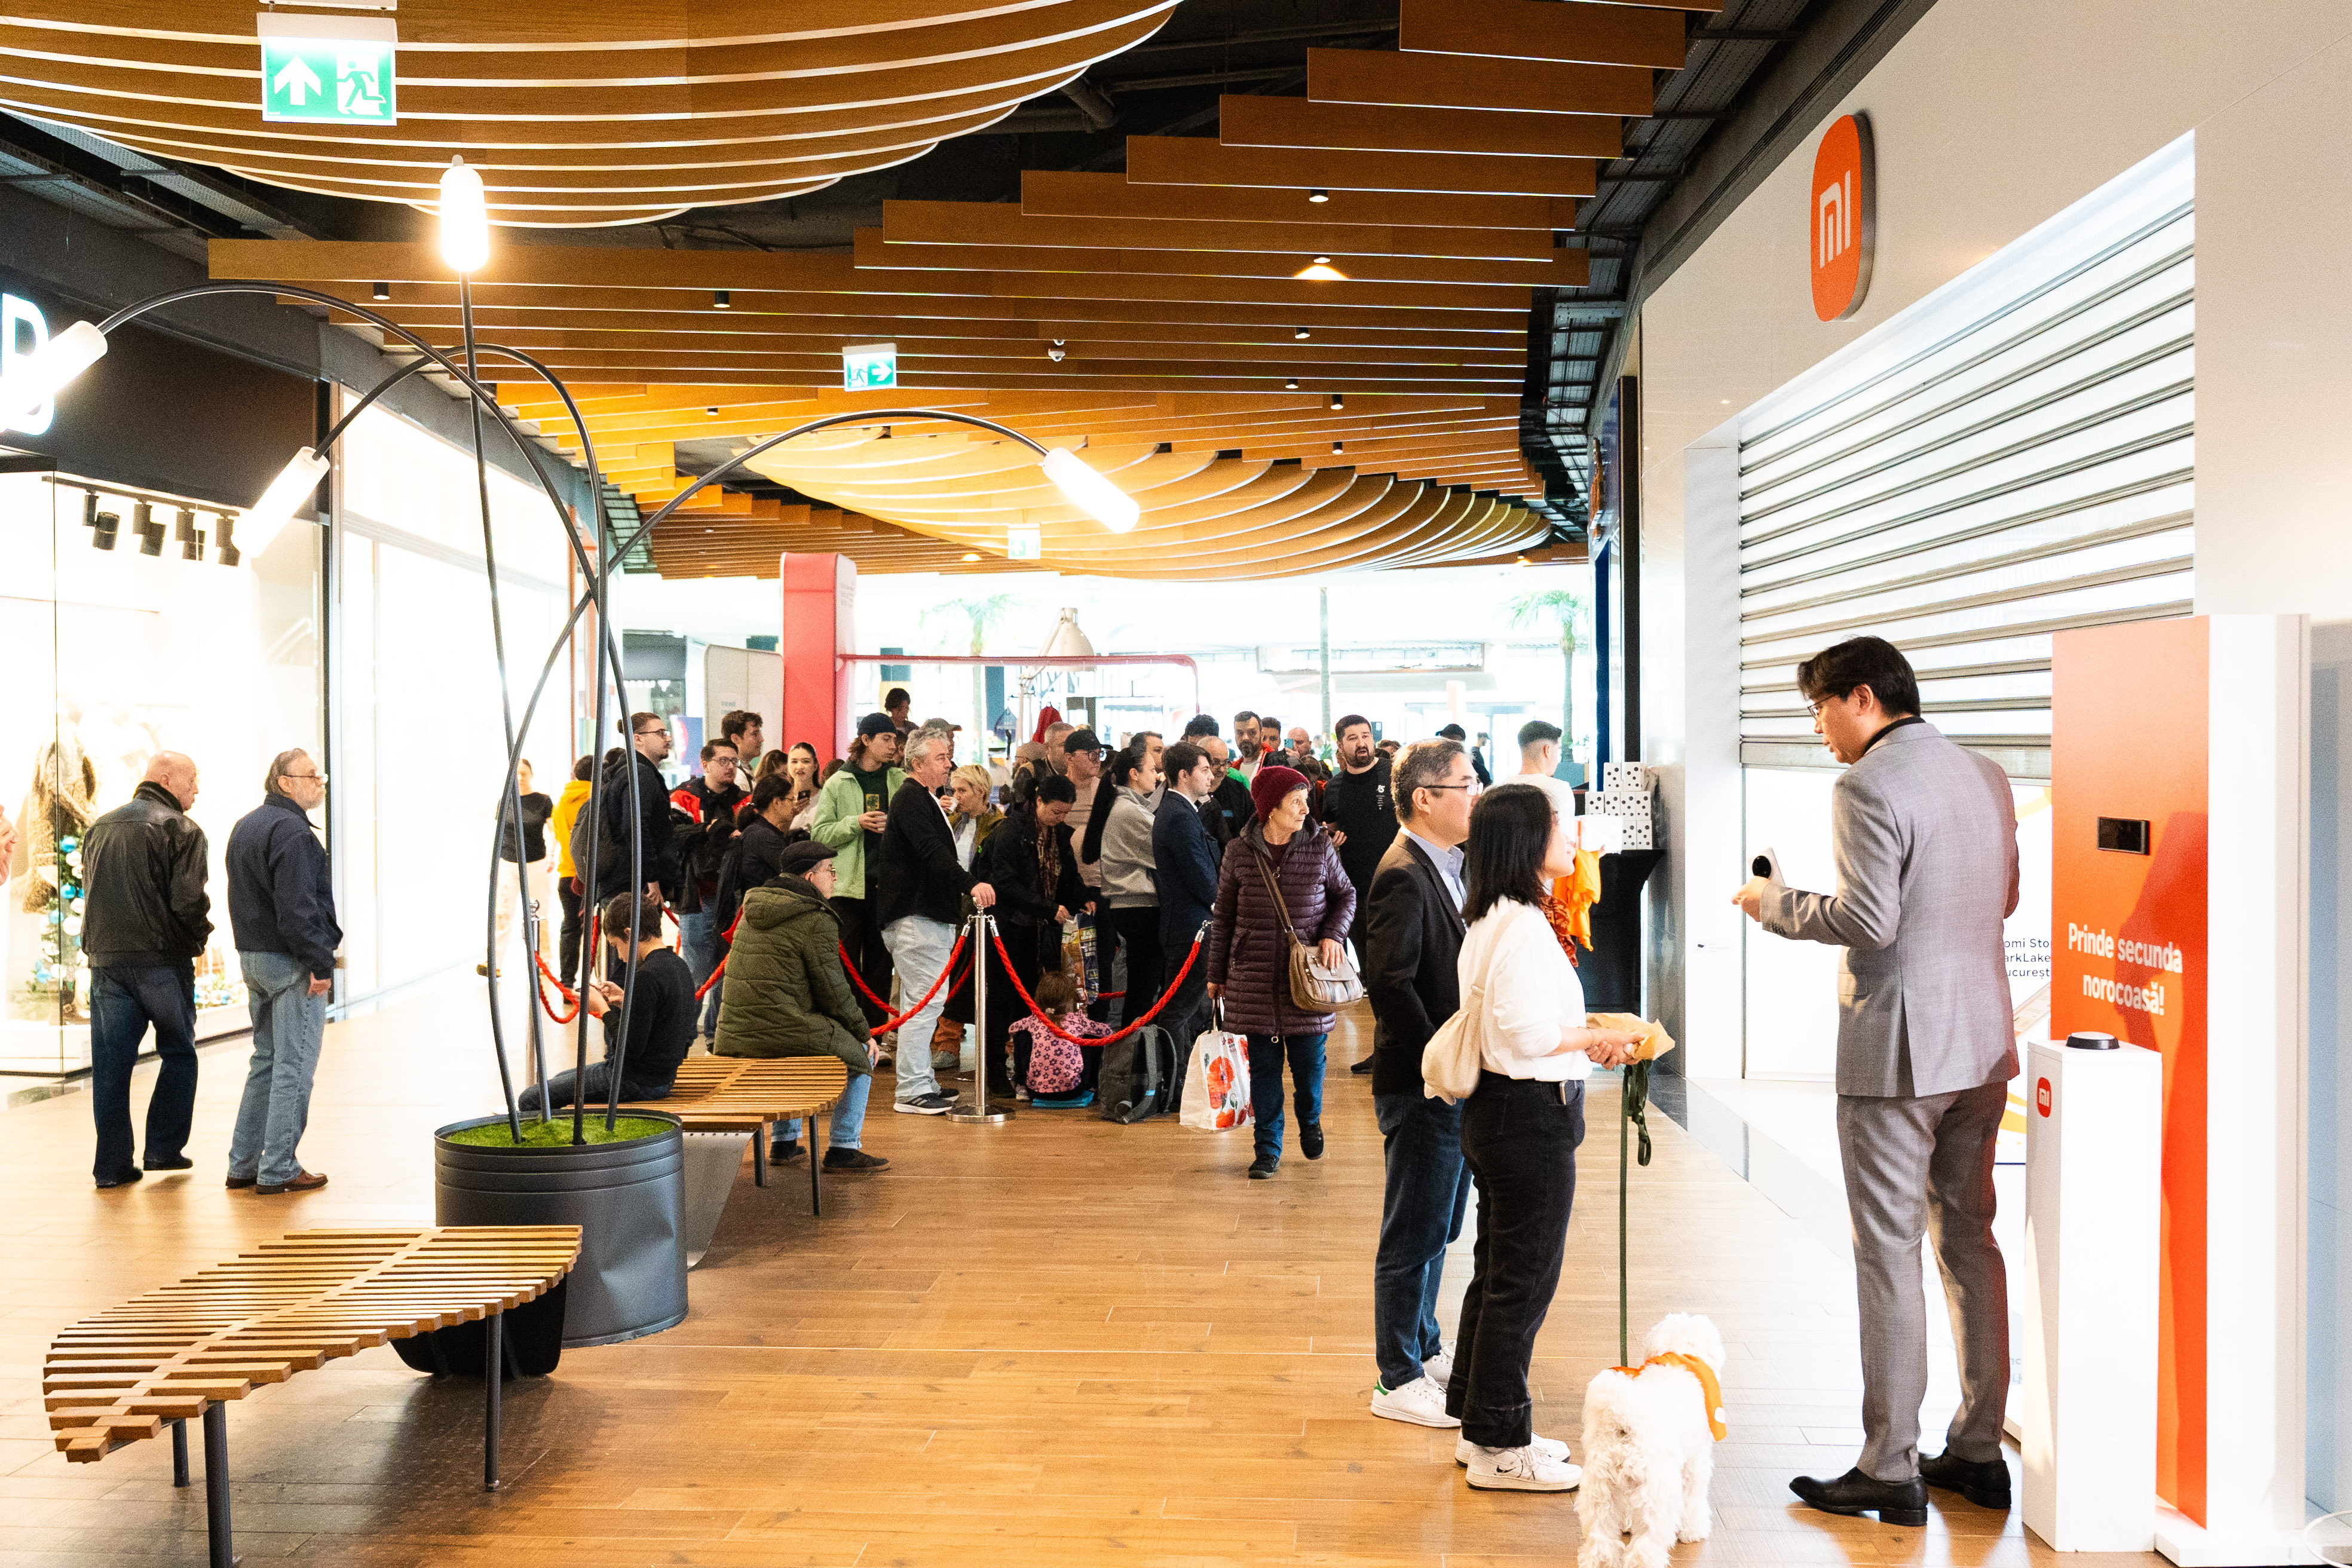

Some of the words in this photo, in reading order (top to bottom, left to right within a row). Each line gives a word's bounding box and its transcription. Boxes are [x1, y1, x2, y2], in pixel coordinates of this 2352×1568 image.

[2068, 922, 2115, 958] Prinde
[2117, 938, 2183, 974] secunda
[2083, 975, 2165, 1016] norocoasă!
